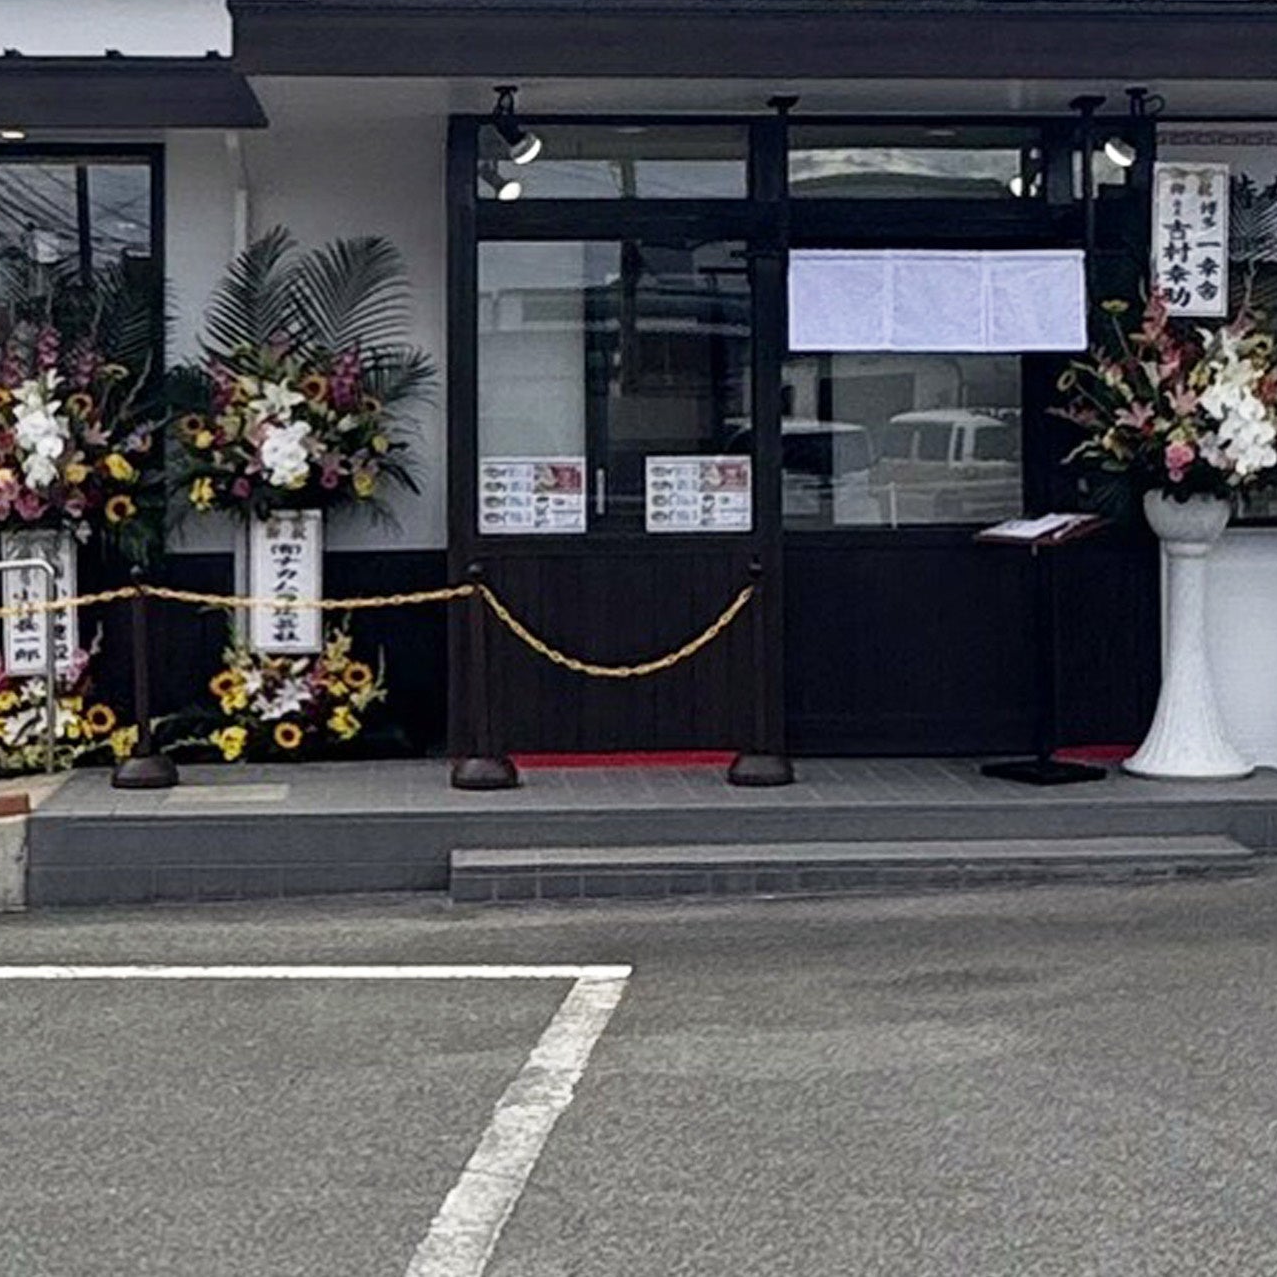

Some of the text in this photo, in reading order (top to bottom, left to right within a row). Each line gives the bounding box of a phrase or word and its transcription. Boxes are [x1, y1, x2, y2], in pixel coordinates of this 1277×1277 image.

[1196, 200, 1221, 302] 博多一幸舎
